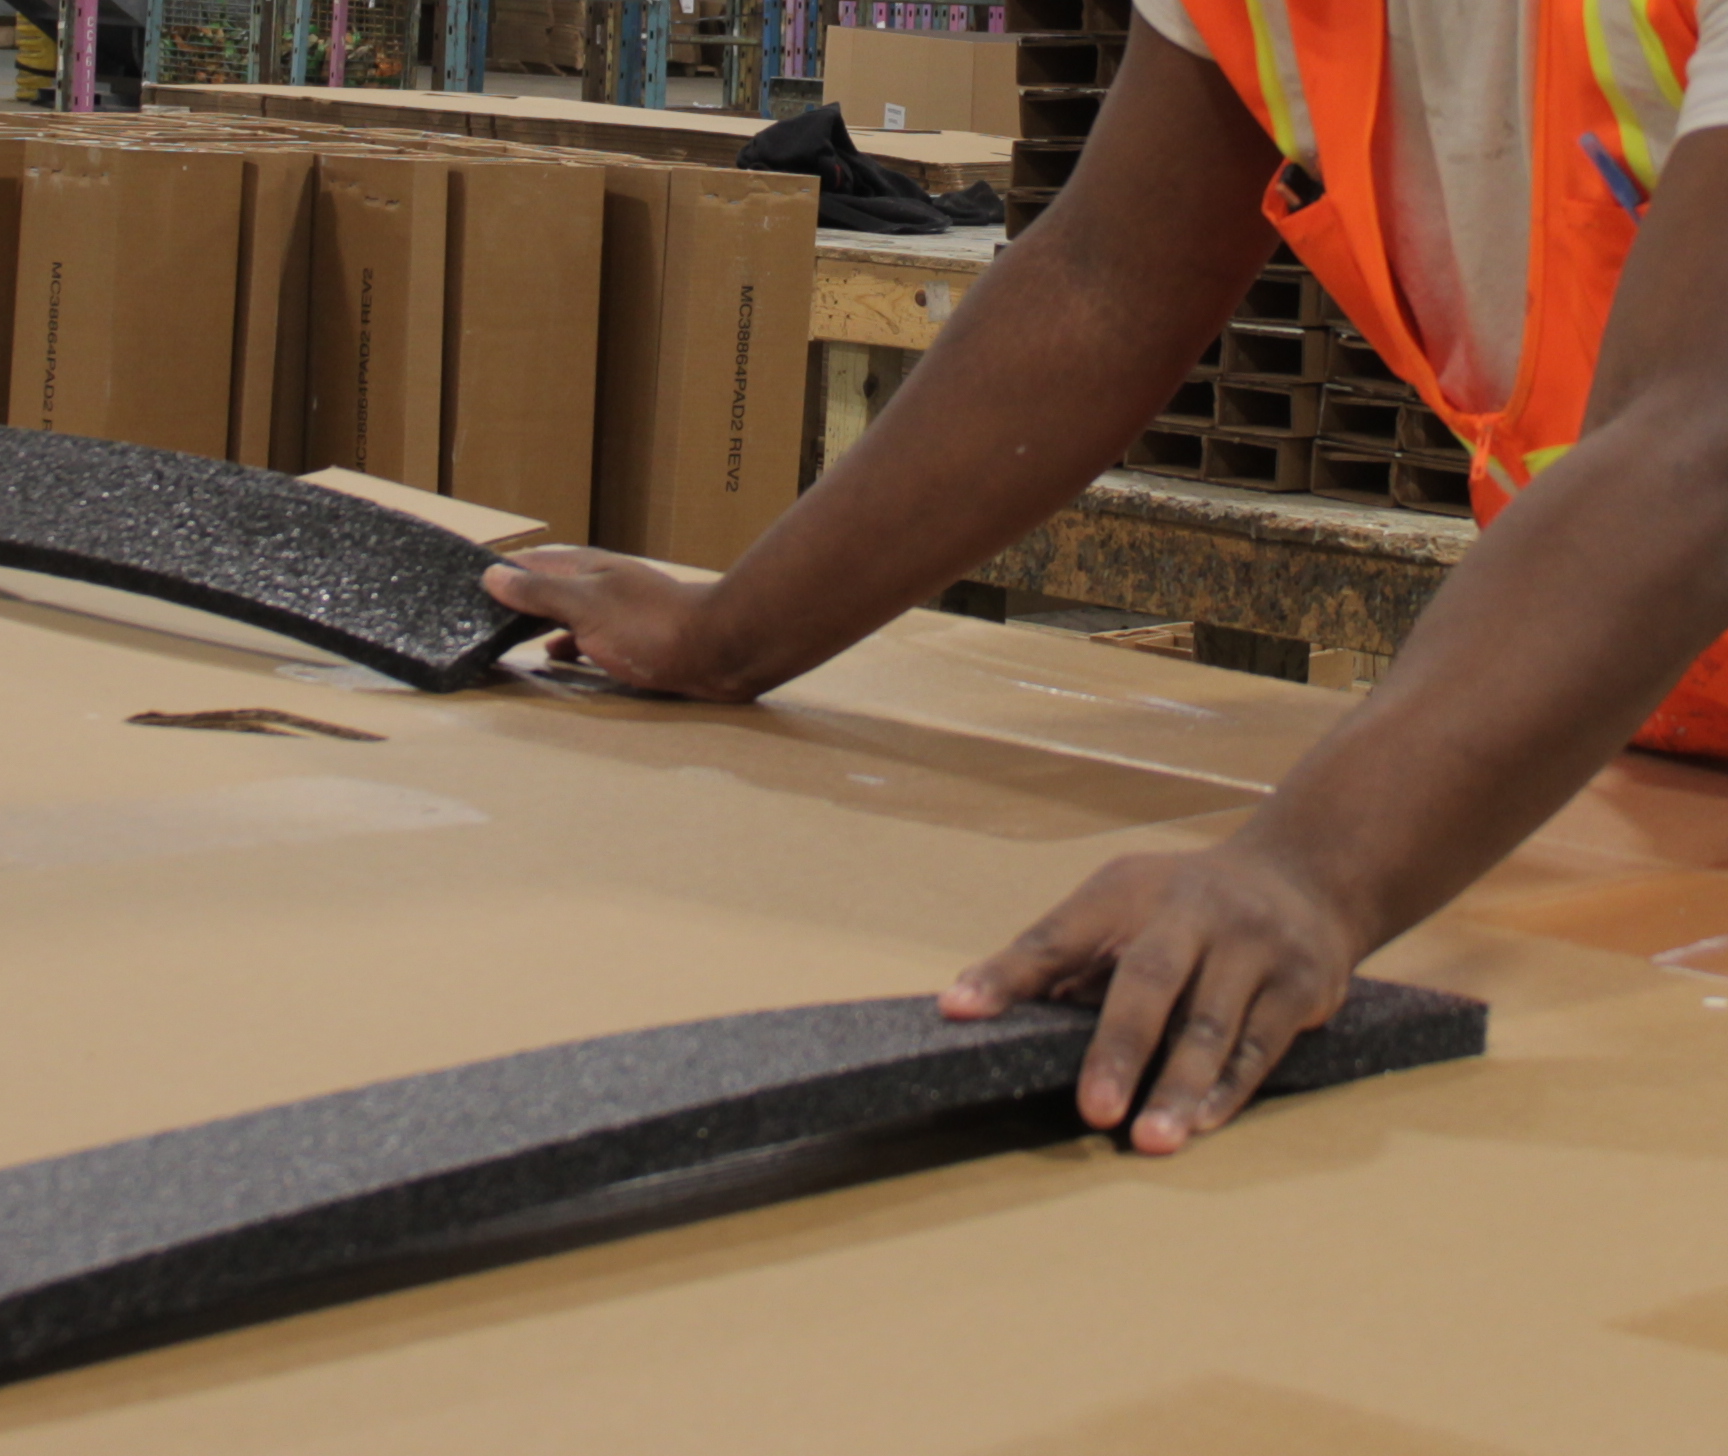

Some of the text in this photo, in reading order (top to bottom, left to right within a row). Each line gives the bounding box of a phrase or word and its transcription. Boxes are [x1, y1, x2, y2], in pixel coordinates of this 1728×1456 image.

[42, 262, 63, 412] MC38864PAD2
[360, 267, 375, 325] REV2
[725, 285, 754, 493] MC38864PAD2 REV2
